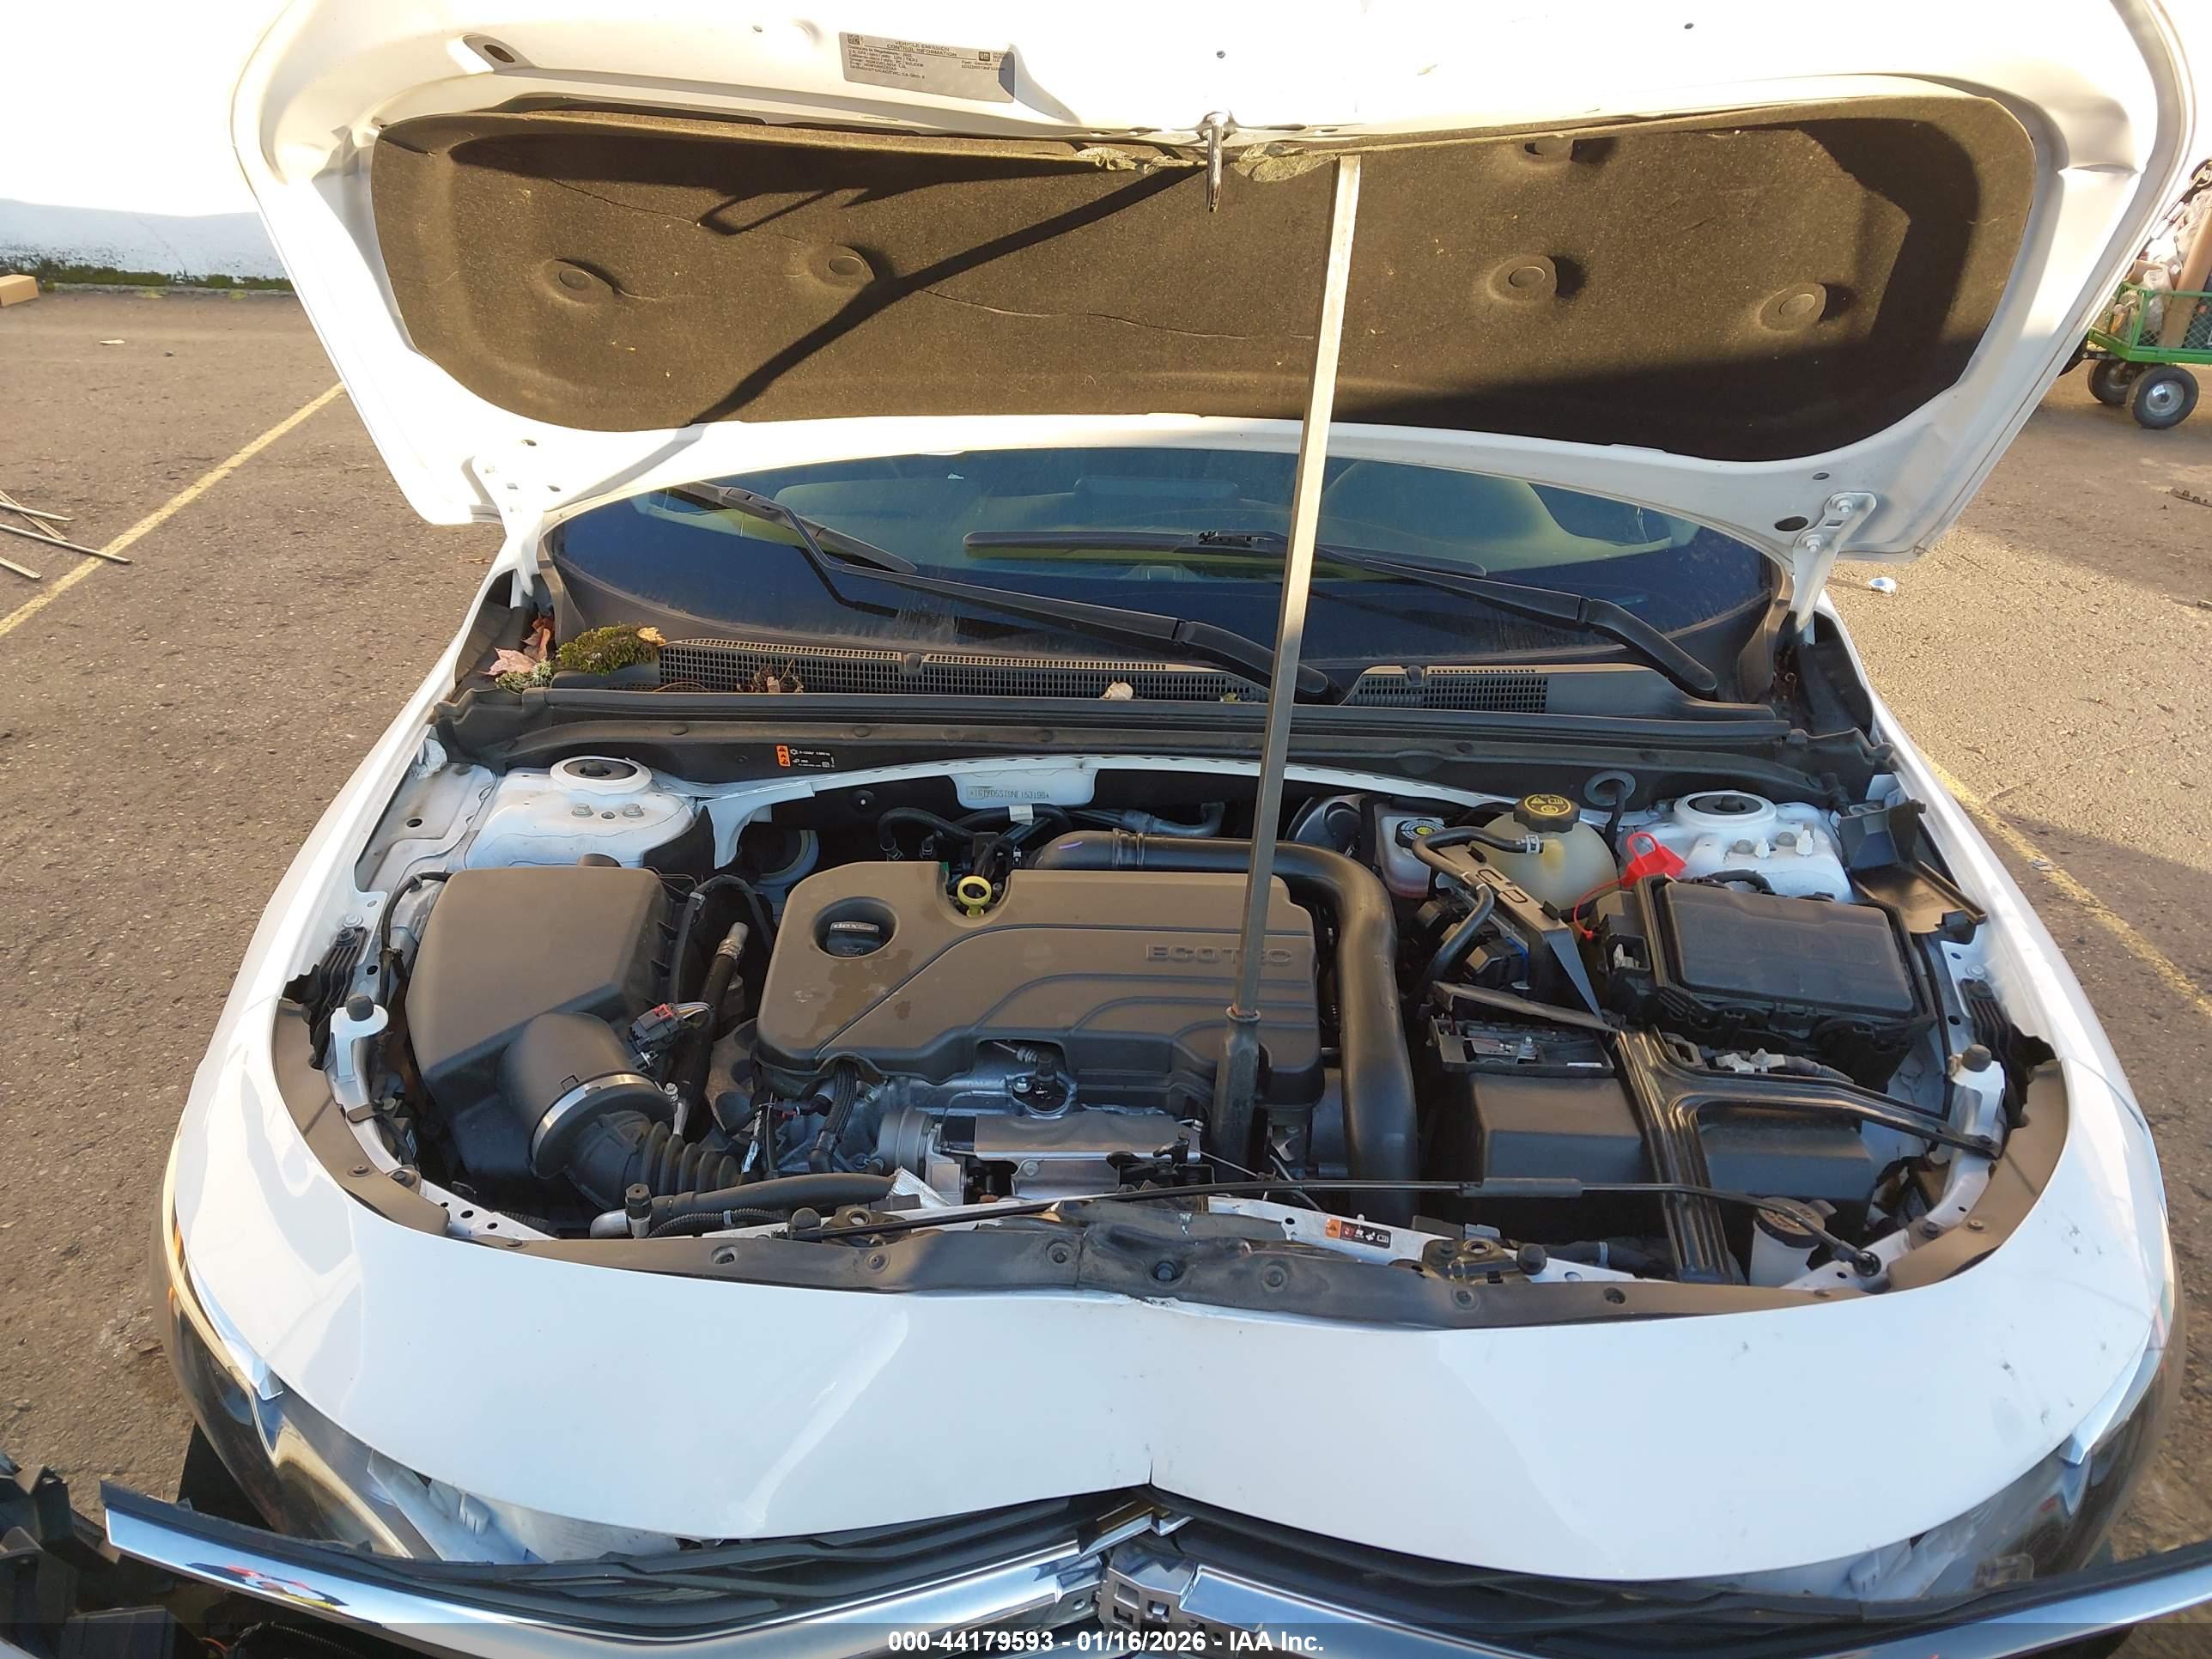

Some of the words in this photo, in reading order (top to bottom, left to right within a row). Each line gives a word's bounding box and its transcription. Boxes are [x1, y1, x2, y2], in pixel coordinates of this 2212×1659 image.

[886, 44, 916, 52] CONTROL
[916, 48, 957, 57] INFORMATION
[921, 43, 950, 52] EMISSION
[1146, 944, 1292, 964] ECOTC
